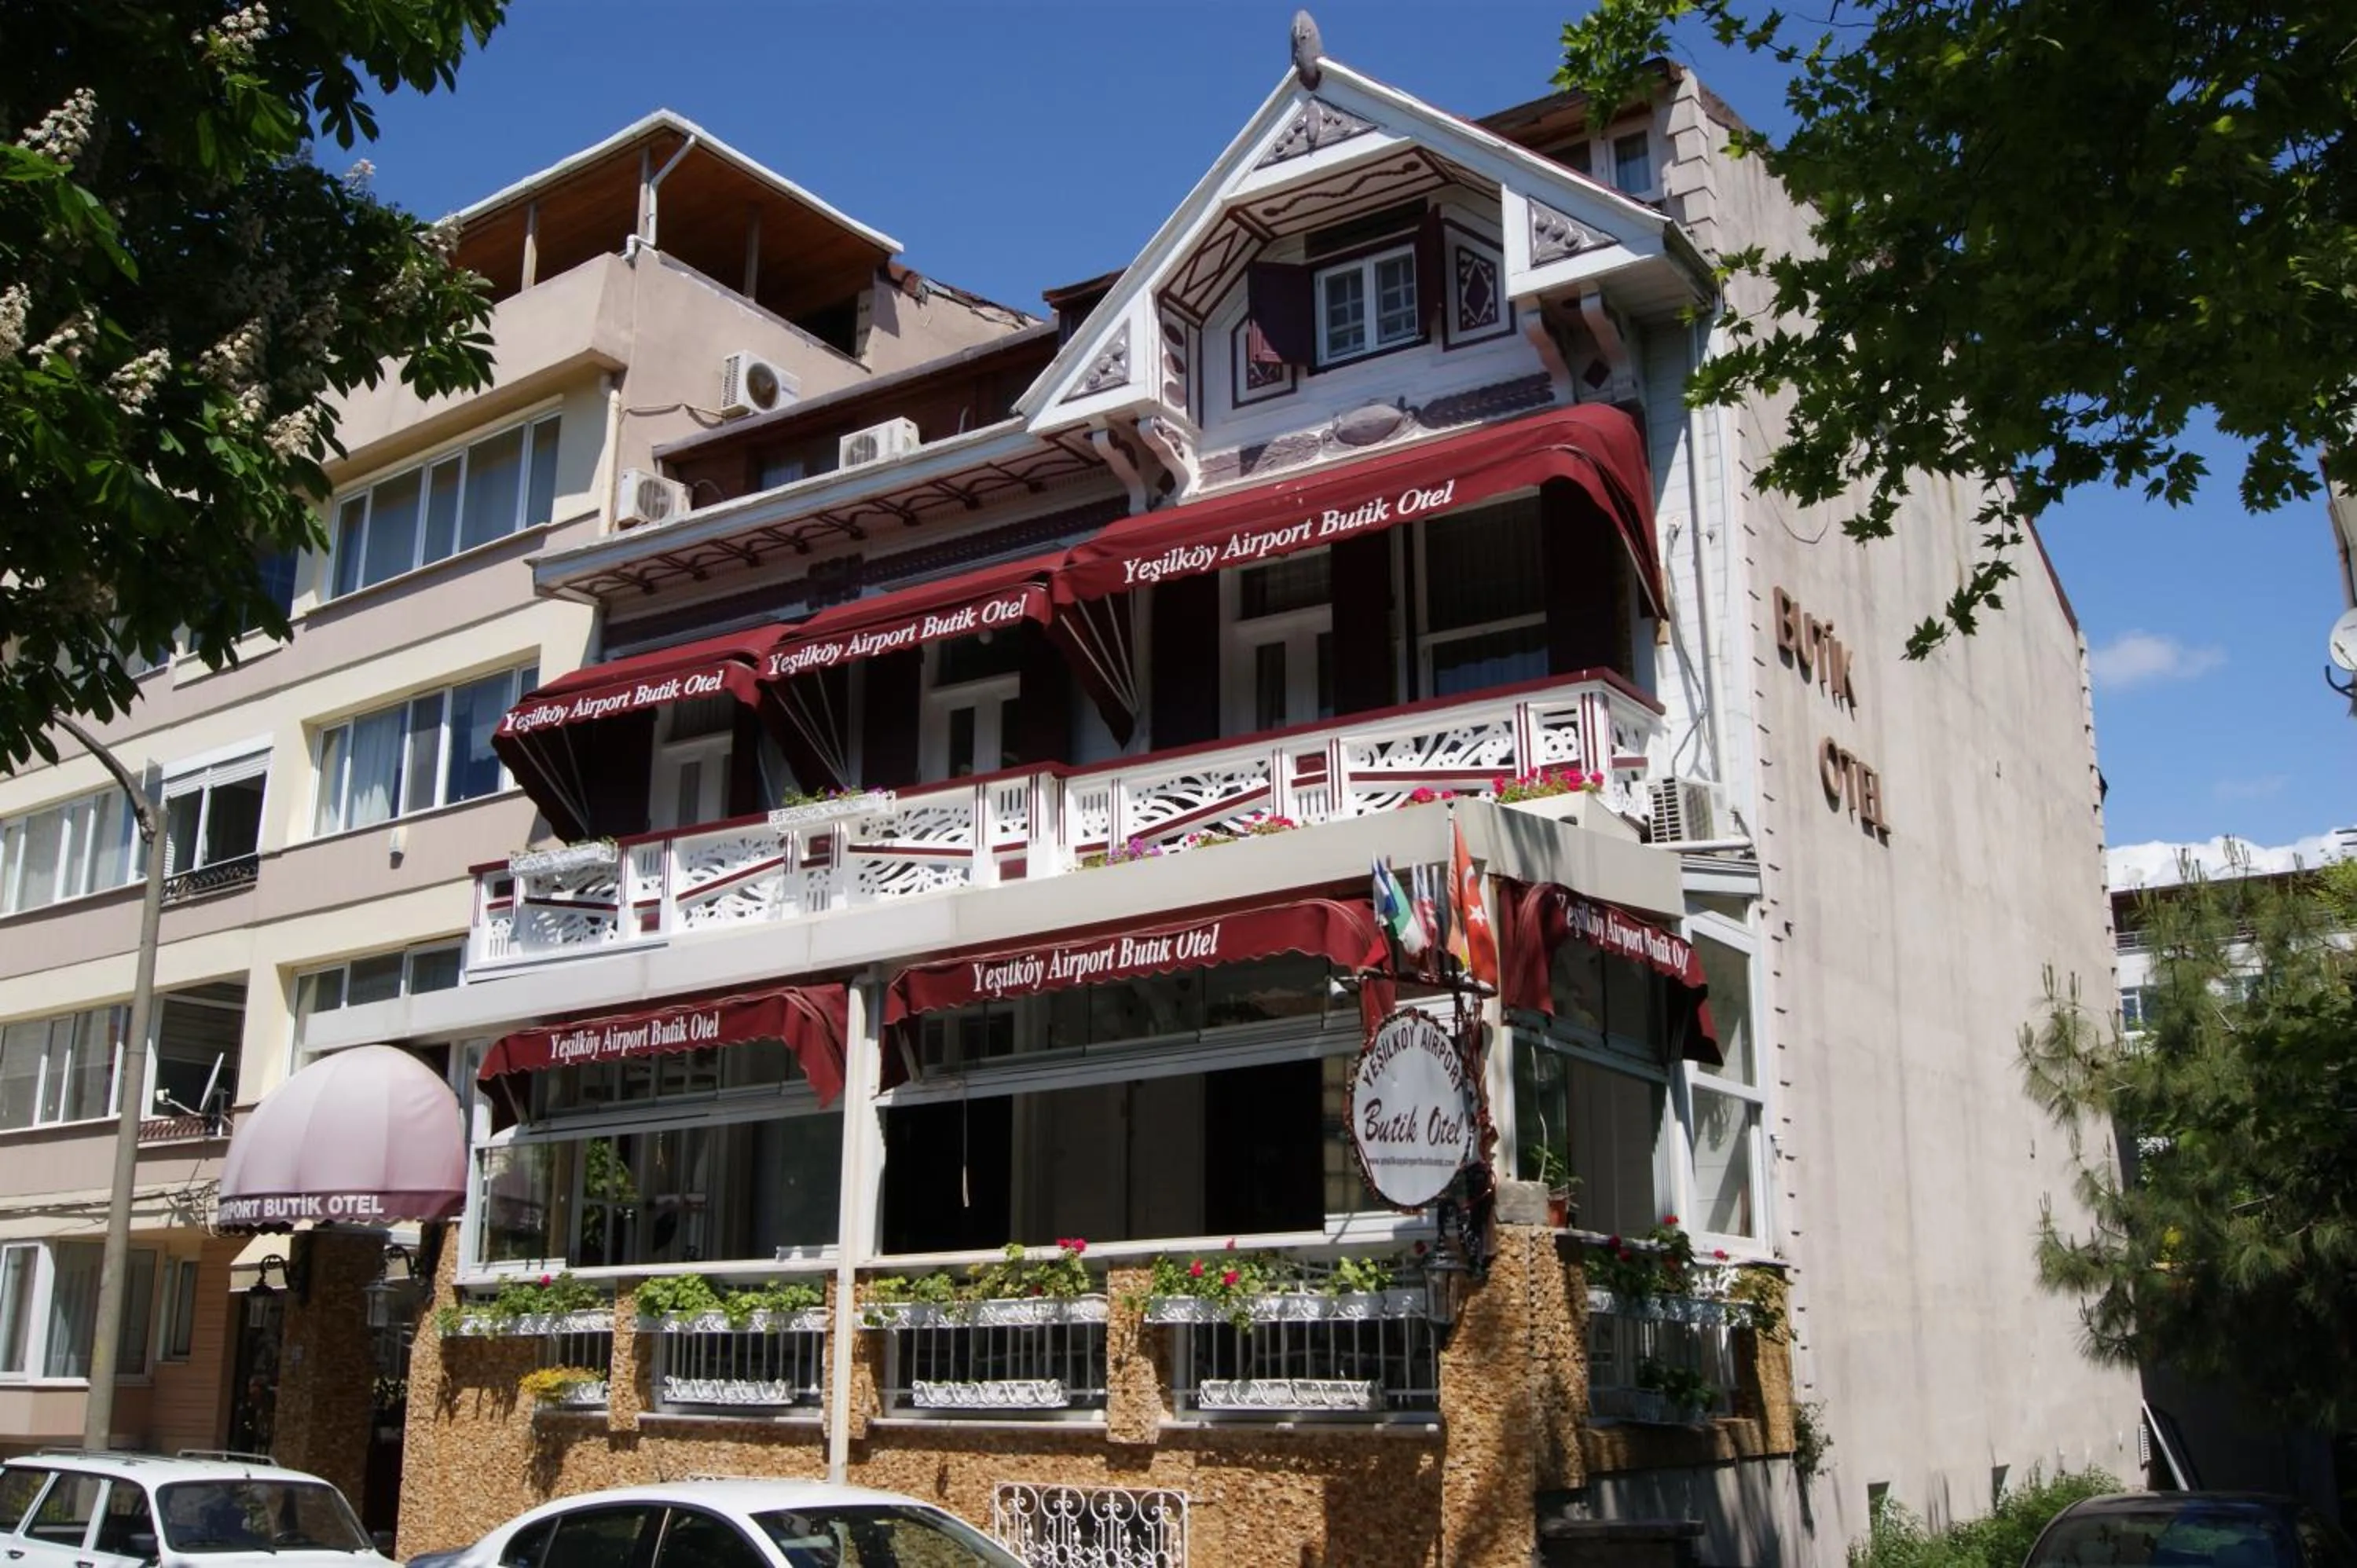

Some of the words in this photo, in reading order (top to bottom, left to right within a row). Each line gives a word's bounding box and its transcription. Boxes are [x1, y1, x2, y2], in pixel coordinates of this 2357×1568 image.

[1123, 546, 1219, 584] Yeşilköy
[1221, 519, 1312, 560] Airport
[1320, 500, 1389, 536] Butik
[1398, 479, 1455, 516] Otel
[768, 643, 843, 676] Yeşilköy
[845, 623, 916, 655] Airport
[921, 607, 977, 639] Butik
[982, 593, 1028, 623] Otel
[503, 706, 569, 732] Yeşilköy
[570, 691, 630, 718] Airport
[633, 682, 680, 705] Butik
[684, 670, 724, 694] Otel
[1819, 736, 1891, 837] OTEL
[1047, 943, 1116, 983] Airport
[1118, 936, 1173, 969] Butik
[1176, 923, 1220, 959] Otel
[1607, 912, 1643, 956] Airport
[550, 1030, 600, 1064] Yeşilköy
[602, 1024, 650, 1057] Airport
[651, 1016, 687, 1046] Butik
[691, 1010, 720, 1041] Otel
[1363, 1098, 1417, 1143] Butik
[1428, 1106, 1464, 1146] Otel
[264, 1194, 322, 1217] BUTİK
[328, 1195, 384, 1214] OTEL
